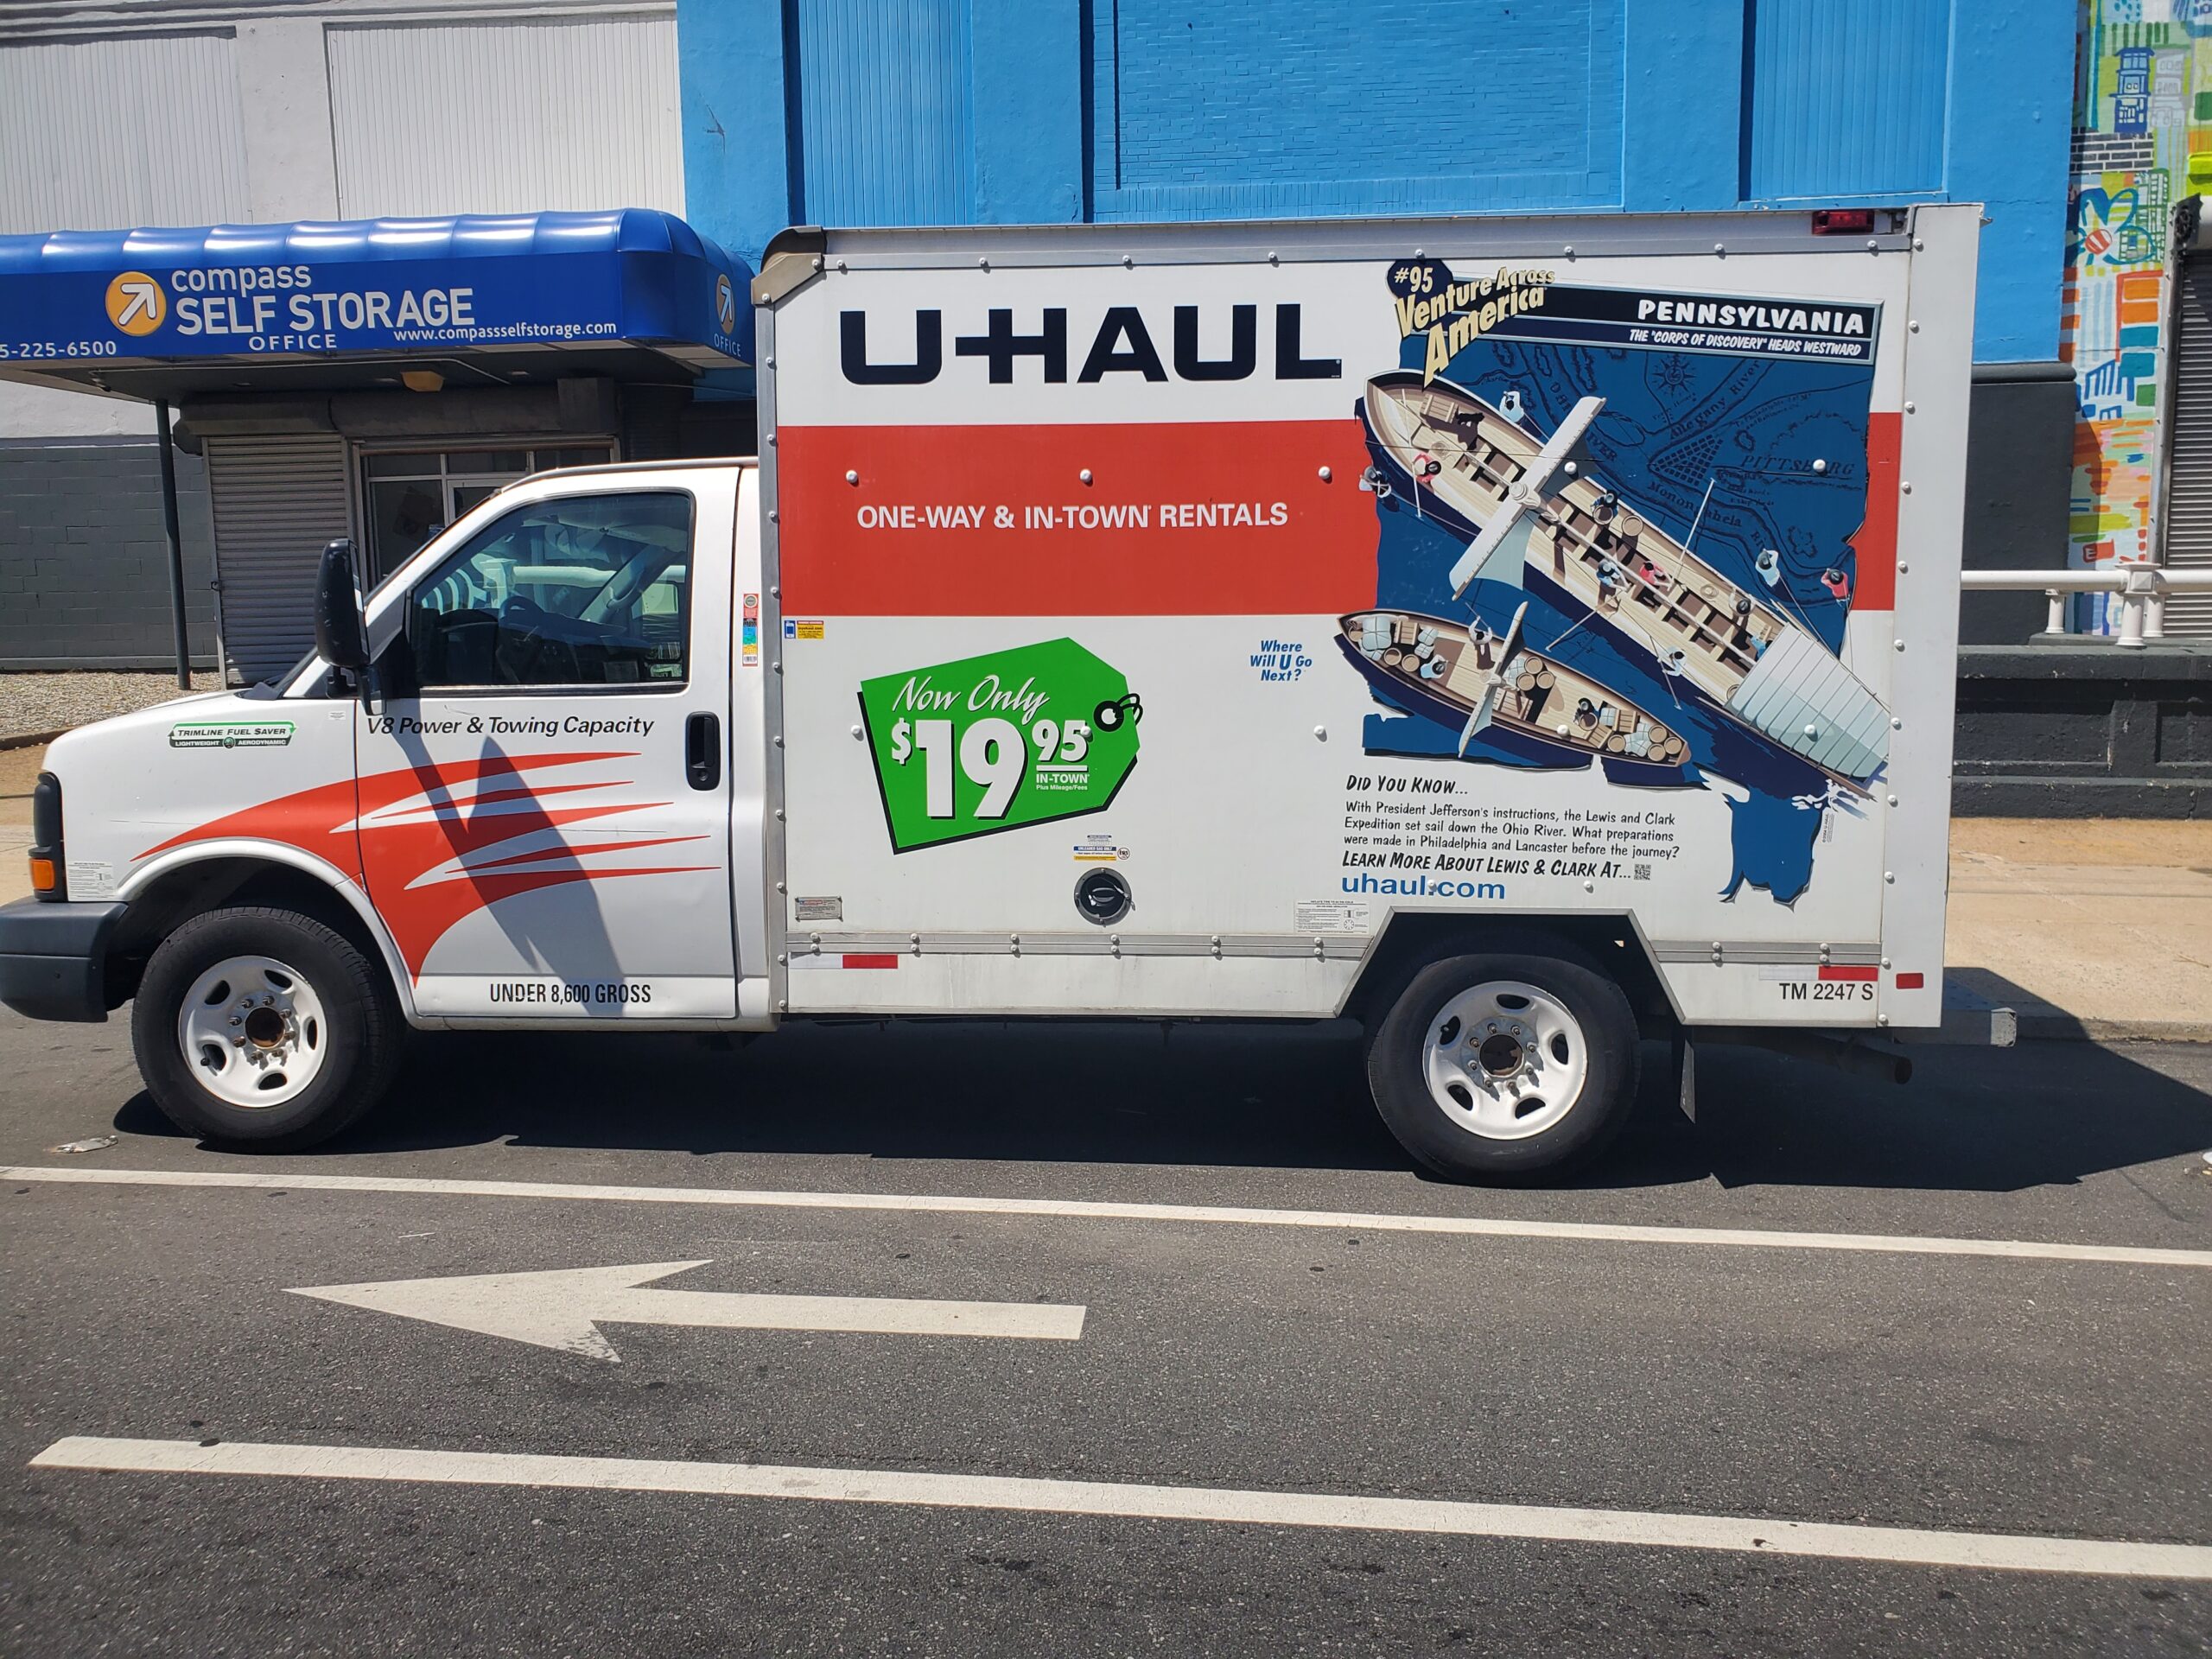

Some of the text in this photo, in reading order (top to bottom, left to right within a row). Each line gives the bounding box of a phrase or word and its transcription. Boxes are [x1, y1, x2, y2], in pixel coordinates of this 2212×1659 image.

[171, 265, 312, 298] compass
[1393, 265, 1434, 294] #95
[175, 288, 475, 335] SELF STORAGE
[1395, 266, 1555, 339] Venture Across
[1637, 299, 1864, 335] PENNSYLVANIA
[248, 334, 338, 352] OFFICE
[393, 321, 617, 343] www.compassselfstorage.com
[839, 302, 1343, 385] U-HAUL
[1423, 286, 1548, 389] America
[1629, 328, 1648, 341] THE
[1689, 333, 1705, 346] OF
[1768, 337, 1801, 353] HEADS
[1802, 340, 1862, 357] WESTWARD
[0, 340, 118, 359] 5-225-6500
[714, 333, 742, 358] OFFICE
[1730, 359, 1762, 396] River
[1740, 454, 1856, 476] PITTSBRG
[856, 502, 1289, 530] ONE-WAY & IN-TOWN RENTALS
[1260, 639, 1303, 652] Where
[1249, 654, 1313, 671] Will U Go
[1260, 668, 1302, 682] Next?
[892, 674, 1051, 726] Now Only
[367, 715, 655, 738] V8 Power & Towing Capacity
[1035, 773, 1089, 784] IN-TOWN
[1345, 774, 1468, 795] DID YOU KNOW...
[1345, 800, 1675, 825] With President Jefferson's instructions, the Lewis and Clark
[1344, 817, 1674, 842] Expedition set sail down the Ohio River. What preparations
[1344, 834, 1680, 861] were made in Philadelphia and Lancaster before the journey?
[1342, 850, 1631, 879] LEARN MORE ABOUT LEWIS & CLARK AT...
[1341, 873, 1505, 899] uhaul.com
[490, 983, 652, 1005] UNDER 8,600 GROSS
[1779, 982, 1873, 1001] TM 2247 S
